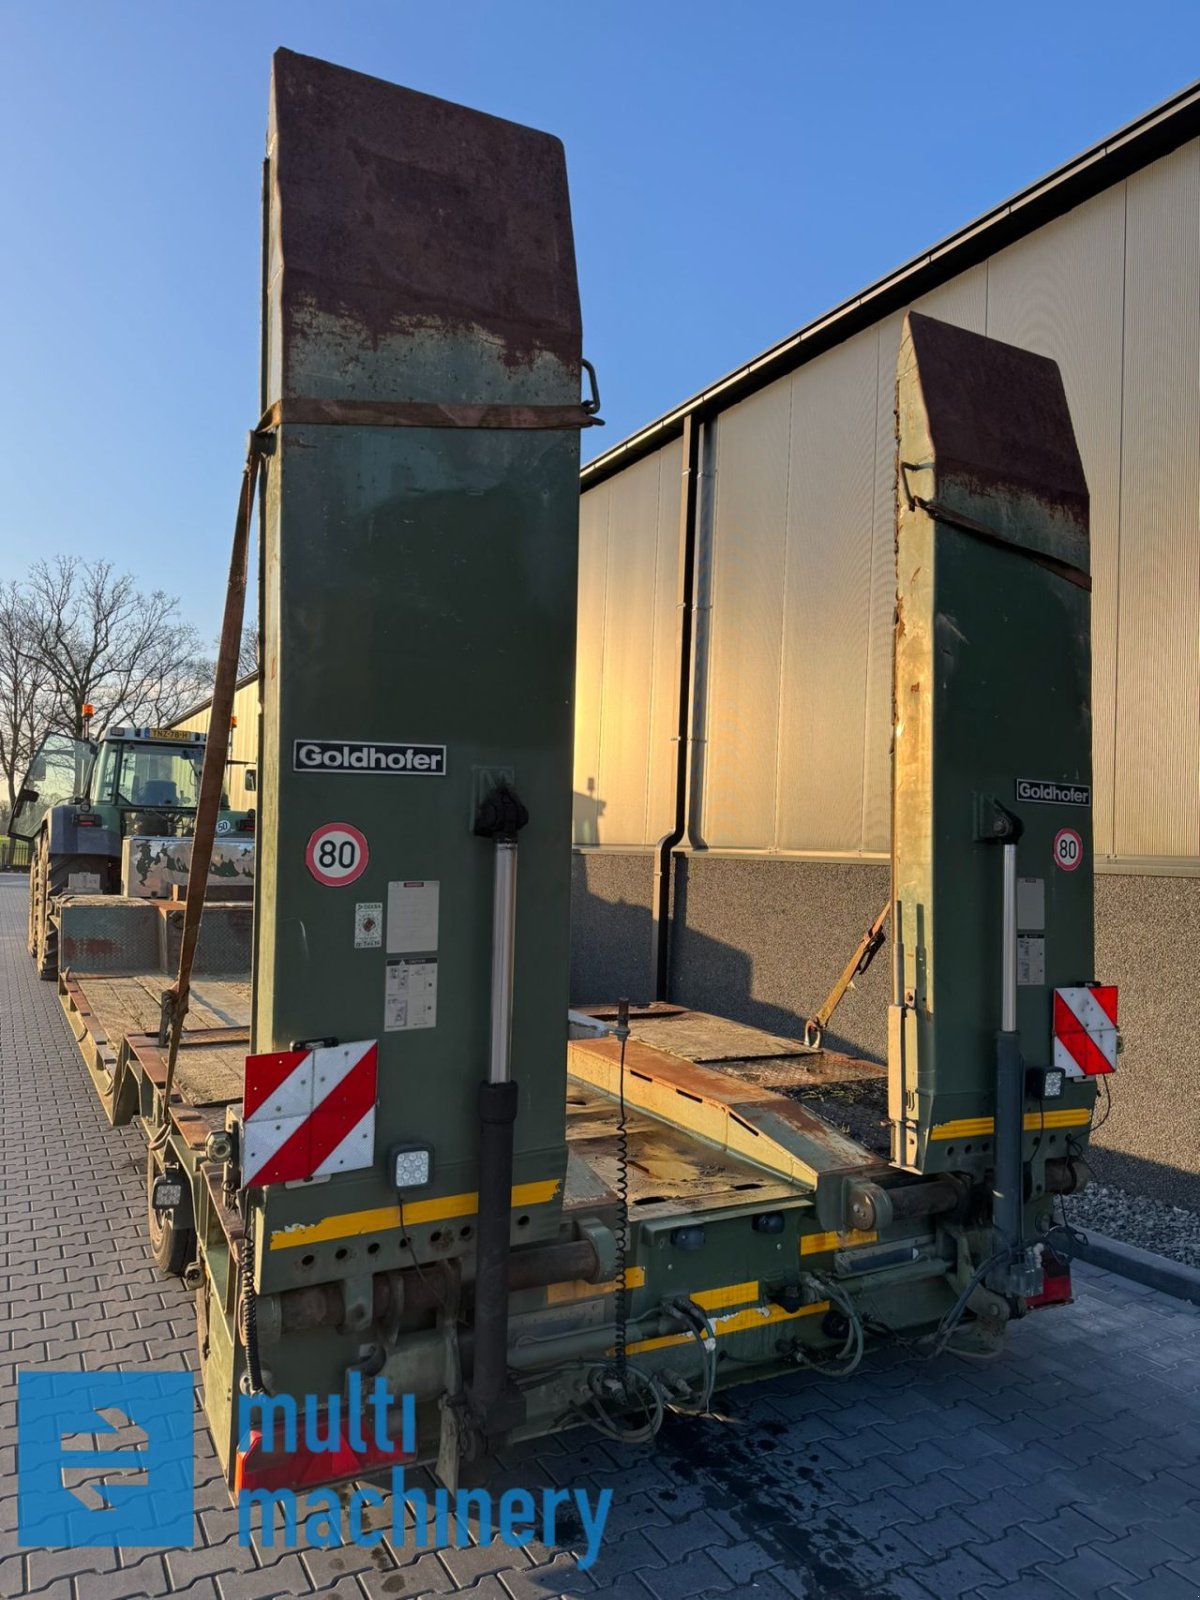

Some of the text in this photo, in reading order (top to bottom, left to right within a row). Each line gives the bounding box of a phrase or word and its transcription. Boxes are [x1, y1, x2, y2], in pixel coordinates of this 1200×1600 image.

[299, 745, 442, 770] Goldhofer
[1020, 783, 1089, 802] Goldhofer
[217, 821, 228, 832] 50
[319, 840, 356, 869] 80
[1060, 839, 1077, 860] 80
